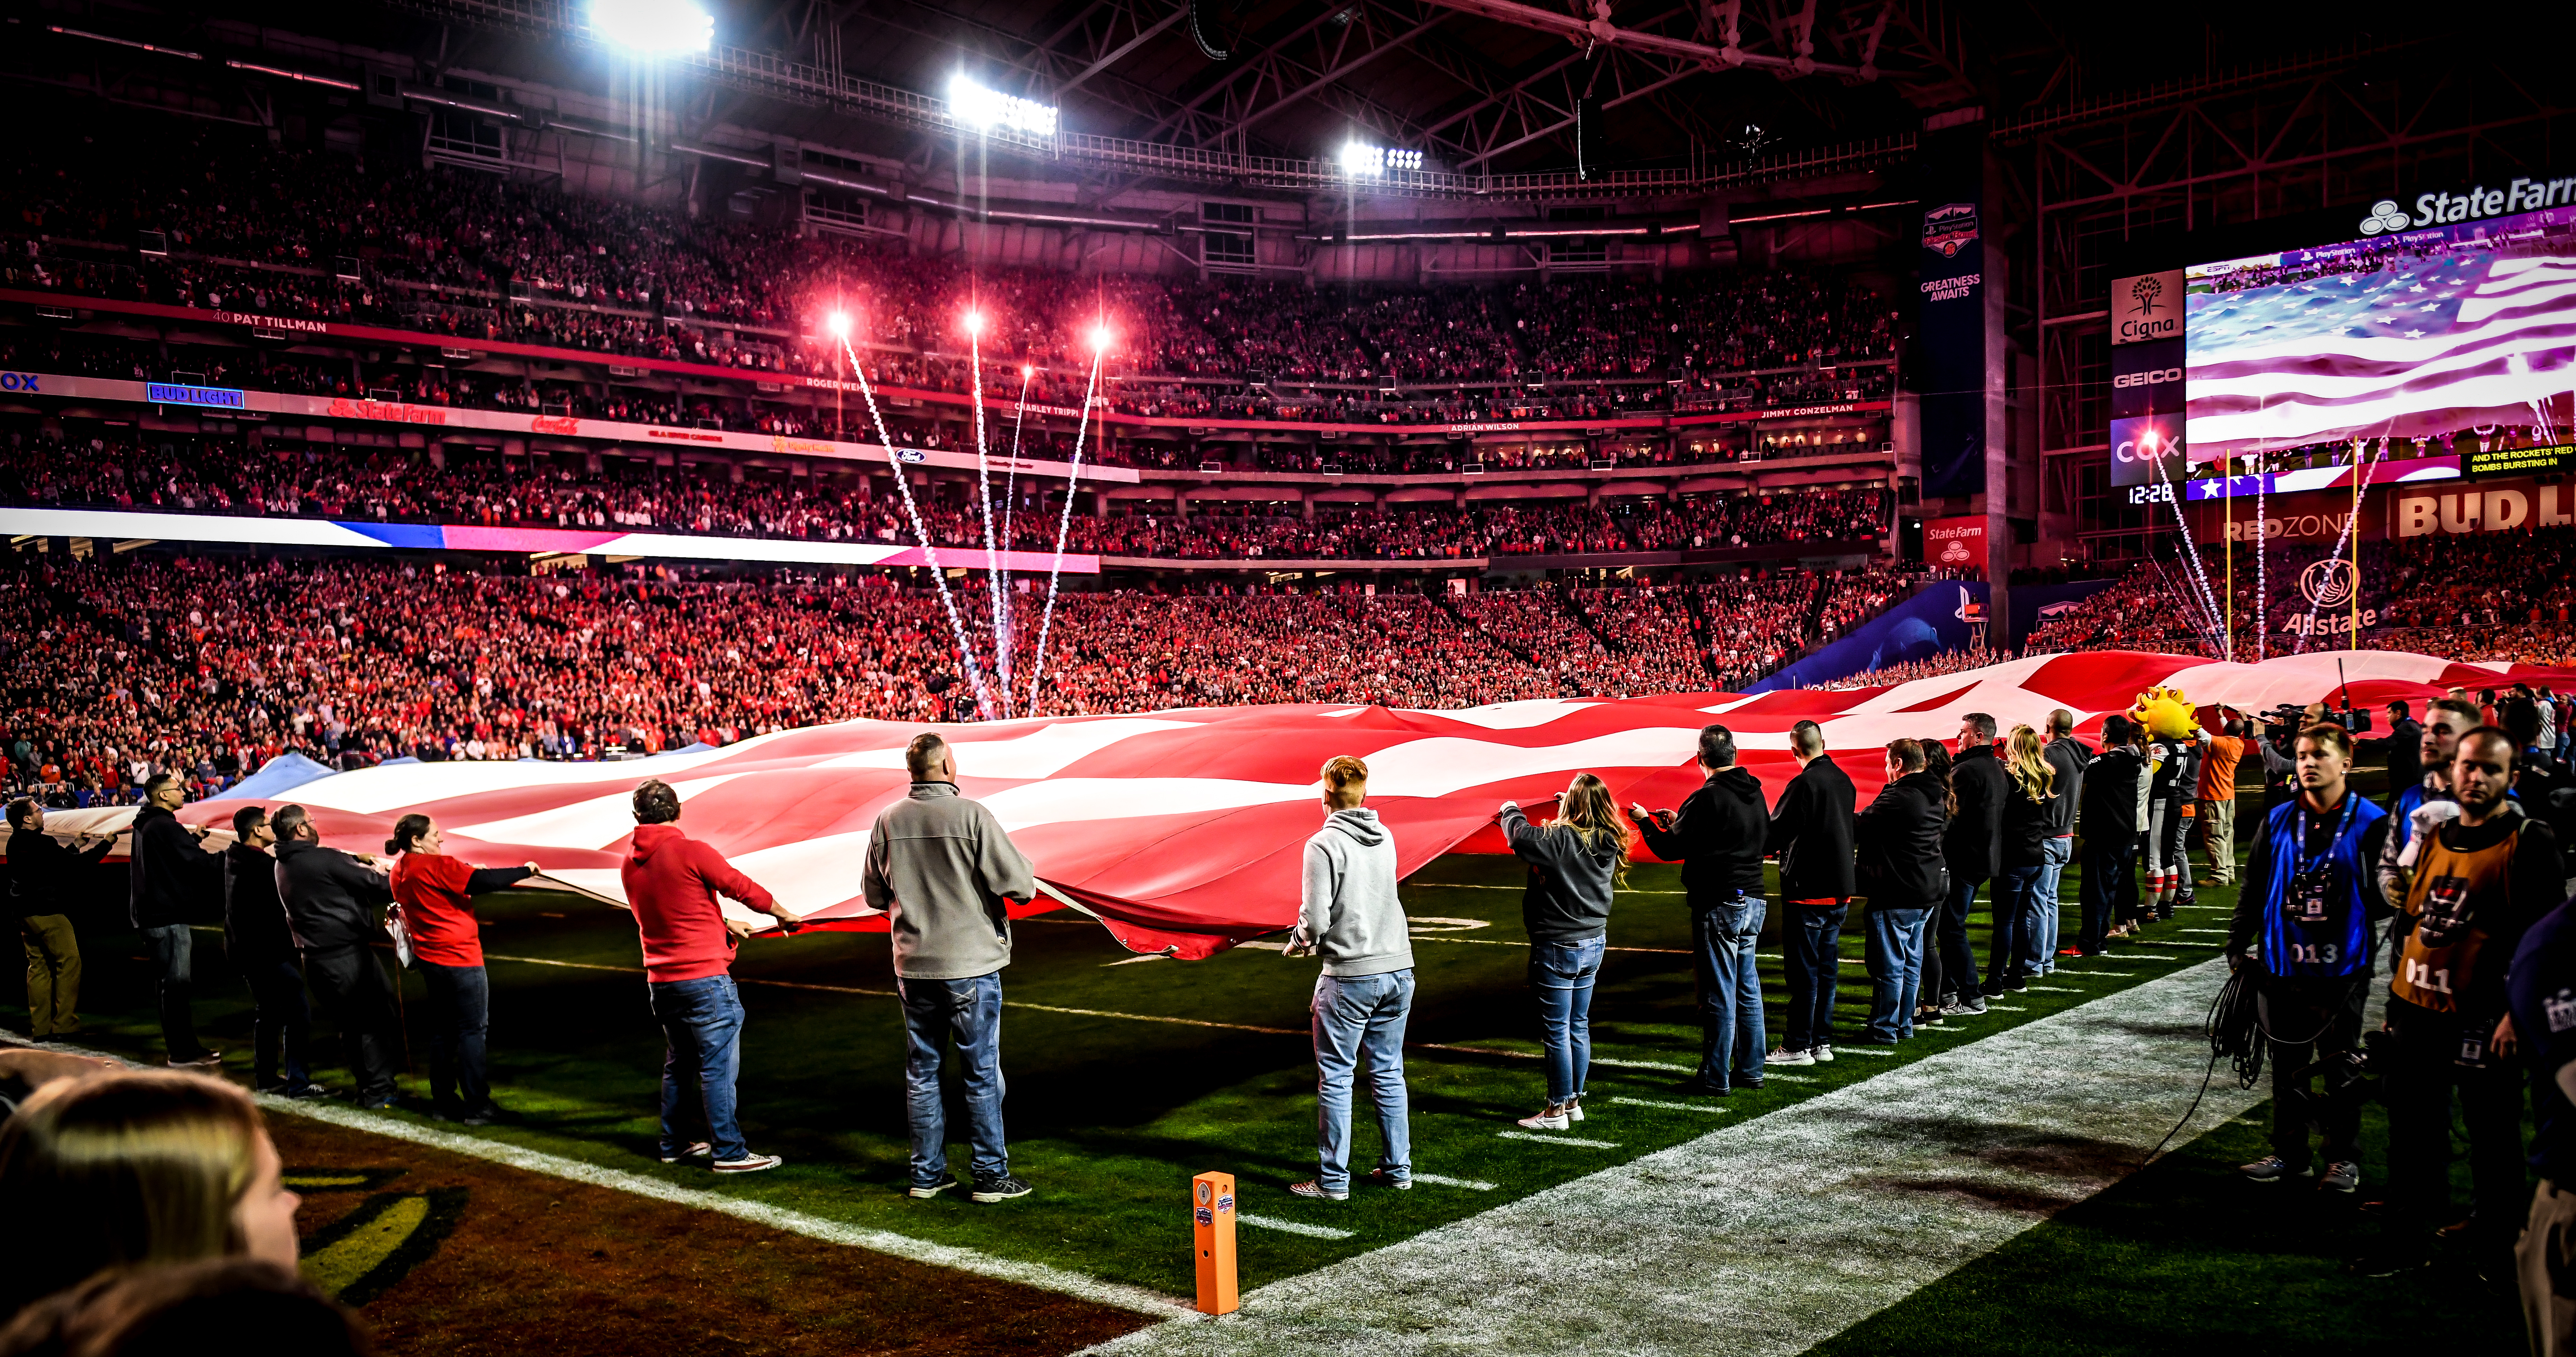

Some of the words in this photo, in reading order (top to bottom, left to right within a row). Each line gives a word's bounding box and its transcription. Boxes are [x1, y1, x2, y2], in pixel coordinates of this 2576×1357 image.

[1939, 222, 1974, 232] PlayStation
[1921, 274, 1980, 293] GREATNESS
[1930, 287, 1969, 302] AWAITS
[213, 312, 229, 322] 40
[234, 313, 260, 325] PAT
[265, 316, 326, 333] TILLMAN
[2121, 318, 2174, 339] Cigna
[807, 378, 839, 389] ROGER
[841, 382, 878, 394] WEHLI
[2114, 368, 2182, 388] GEICO
[152, 386, 189, 400] BUD
[191, 389, 240, 405] LIGHT
[1053, 407, 1079, 417] TRIPPI
[1761, 410, 1792, 418] JIMMY
[1793, 405, 1853, 415] CONZELMAN
[902, 450, 921, 461] Ford
[2117, 436, 2180, 463] COX
[2510, 448, 2553, 459] ROCKETS'
[2555, 446, 2573, 454] RED
[2472, 463, 2502, 472] BOMBS
[2503, 459, 2546, 469] BURSTING
[2129, 483, 2172, 504] 12:28
[2400, 490, 2528, 537] BUD
[2281, 609, 2376, 635] Allstate
[2289, 944, 2338, 963] 013
[2406, 958, 2452, 994] 011
